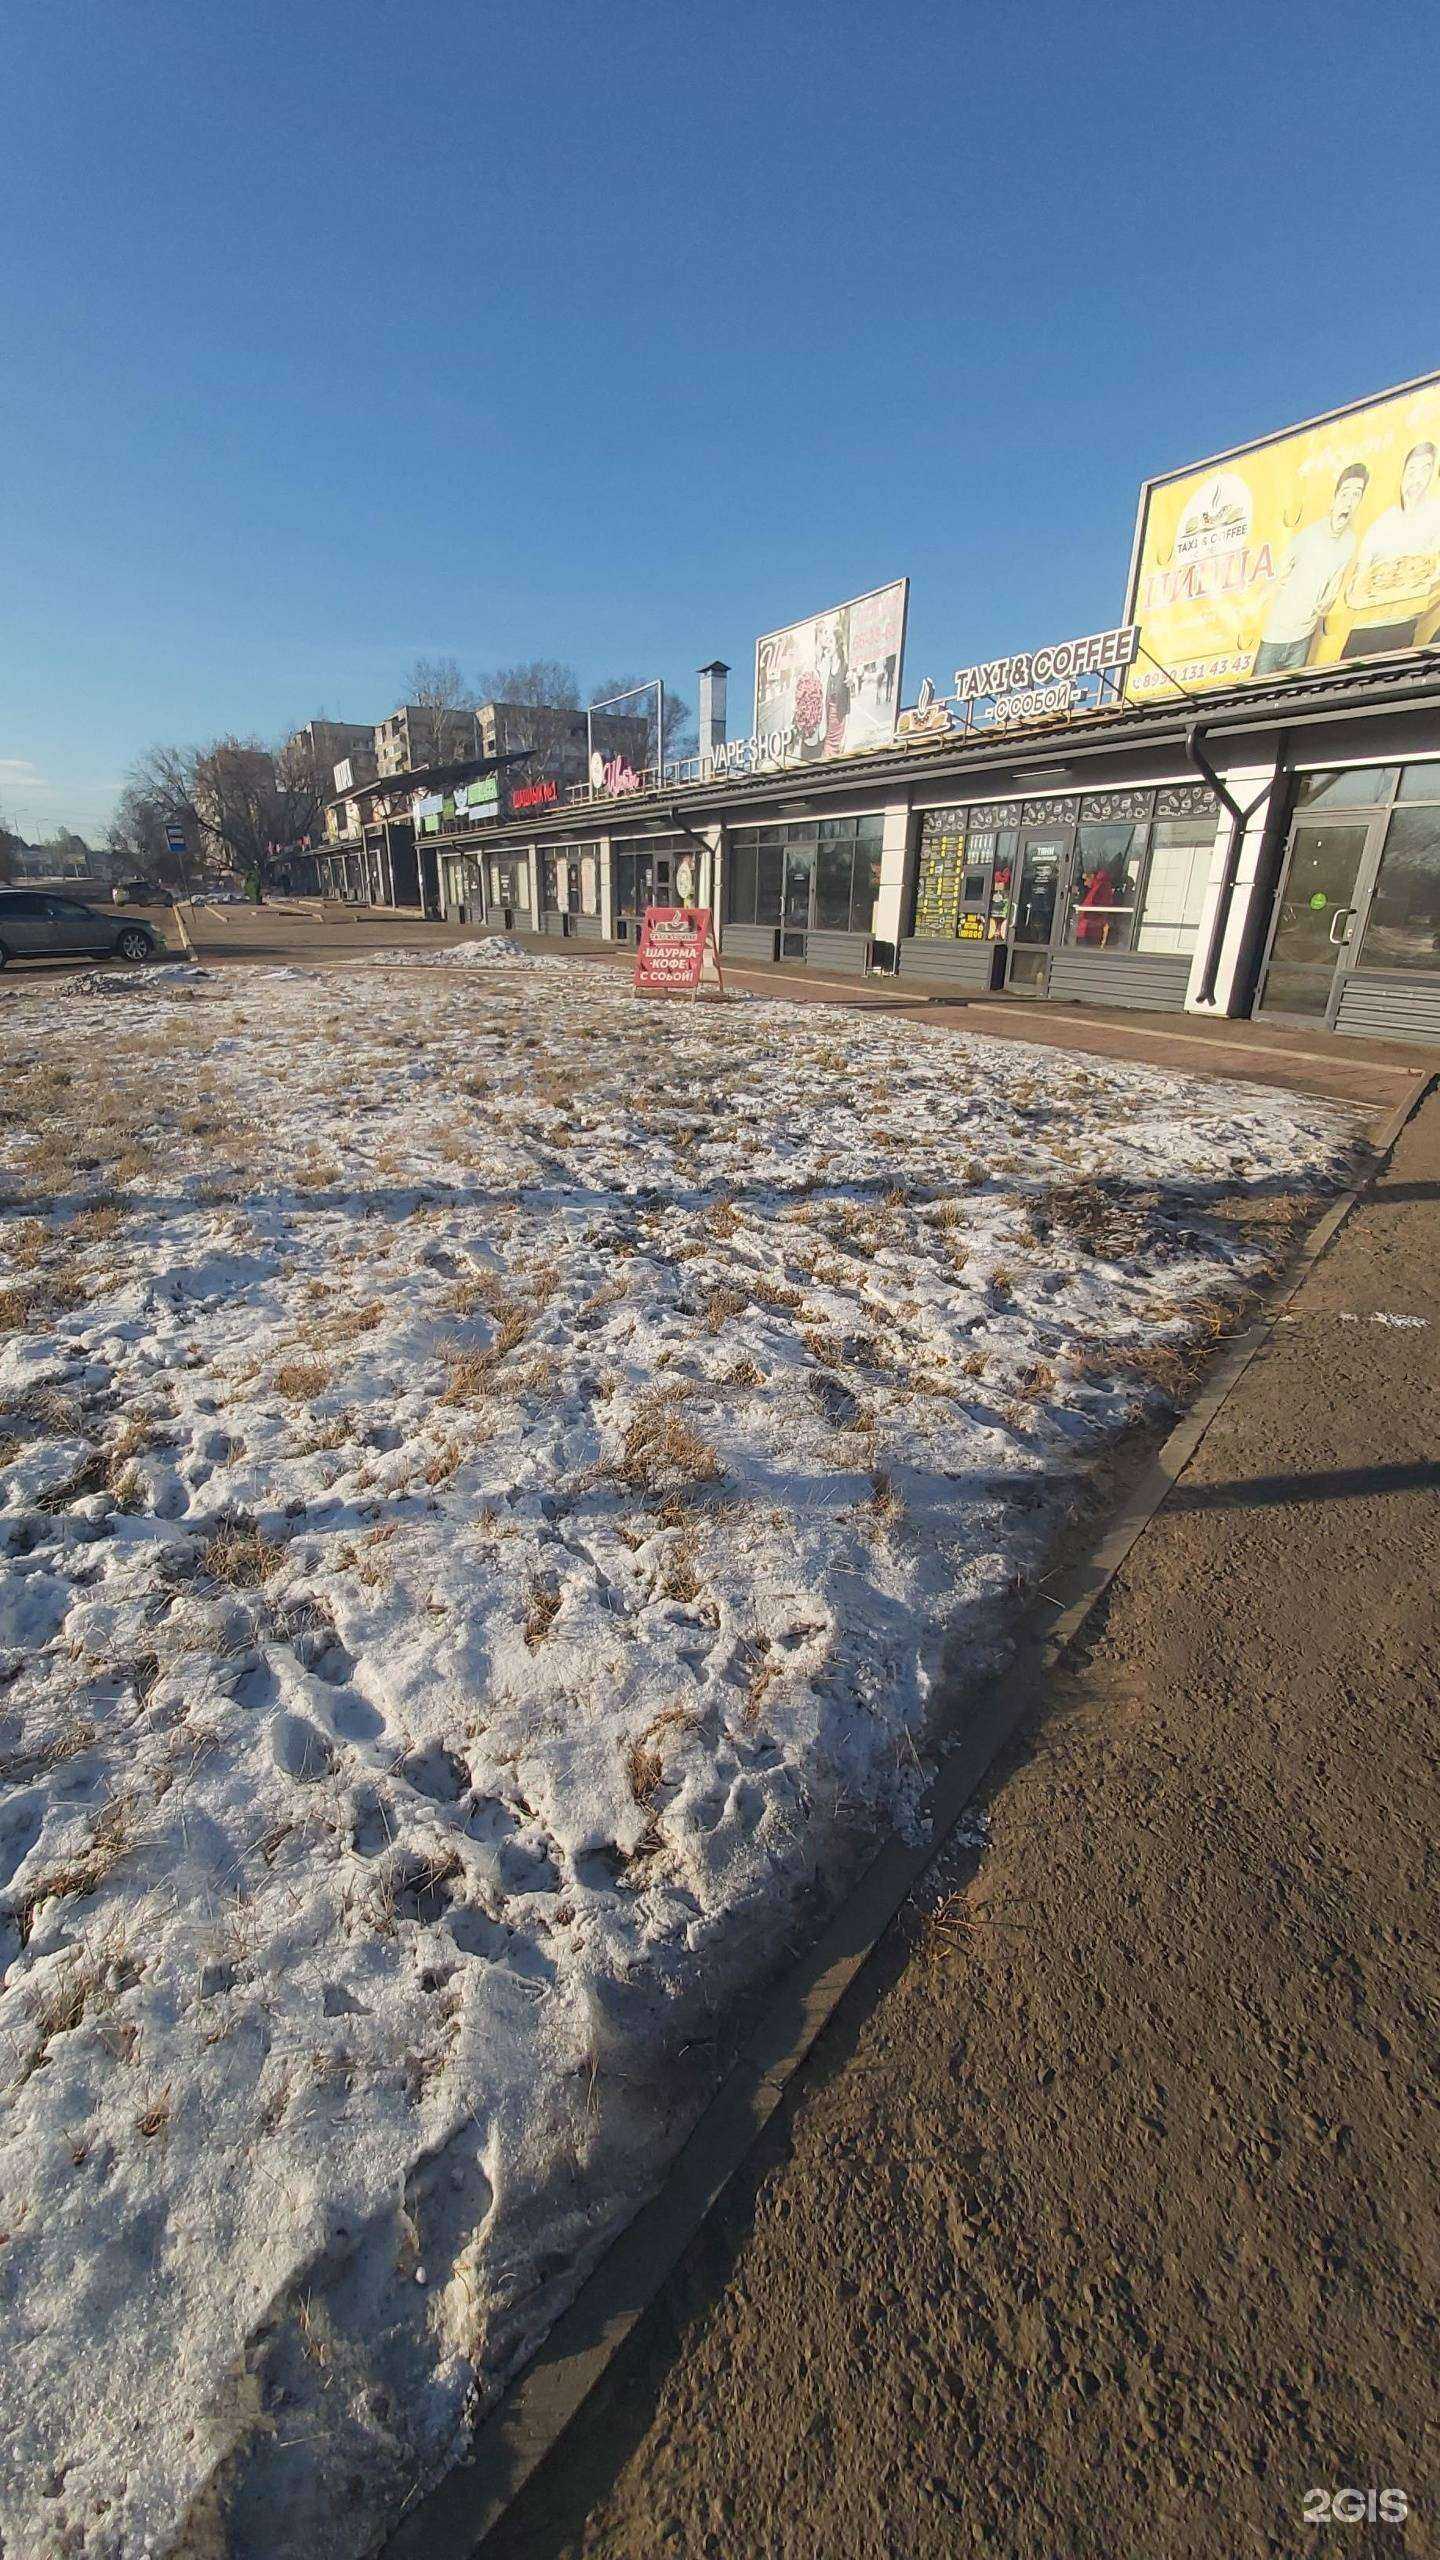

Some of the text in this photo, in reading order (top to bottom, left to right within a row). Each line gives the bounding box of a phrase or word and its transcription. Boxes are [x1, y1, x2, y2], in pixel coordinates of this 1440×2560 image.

[1210, 524, 1248, 544] CFFEE
[711, 728, 792, 769] VAPE SHOP
[640, 972, 648, 980] С
